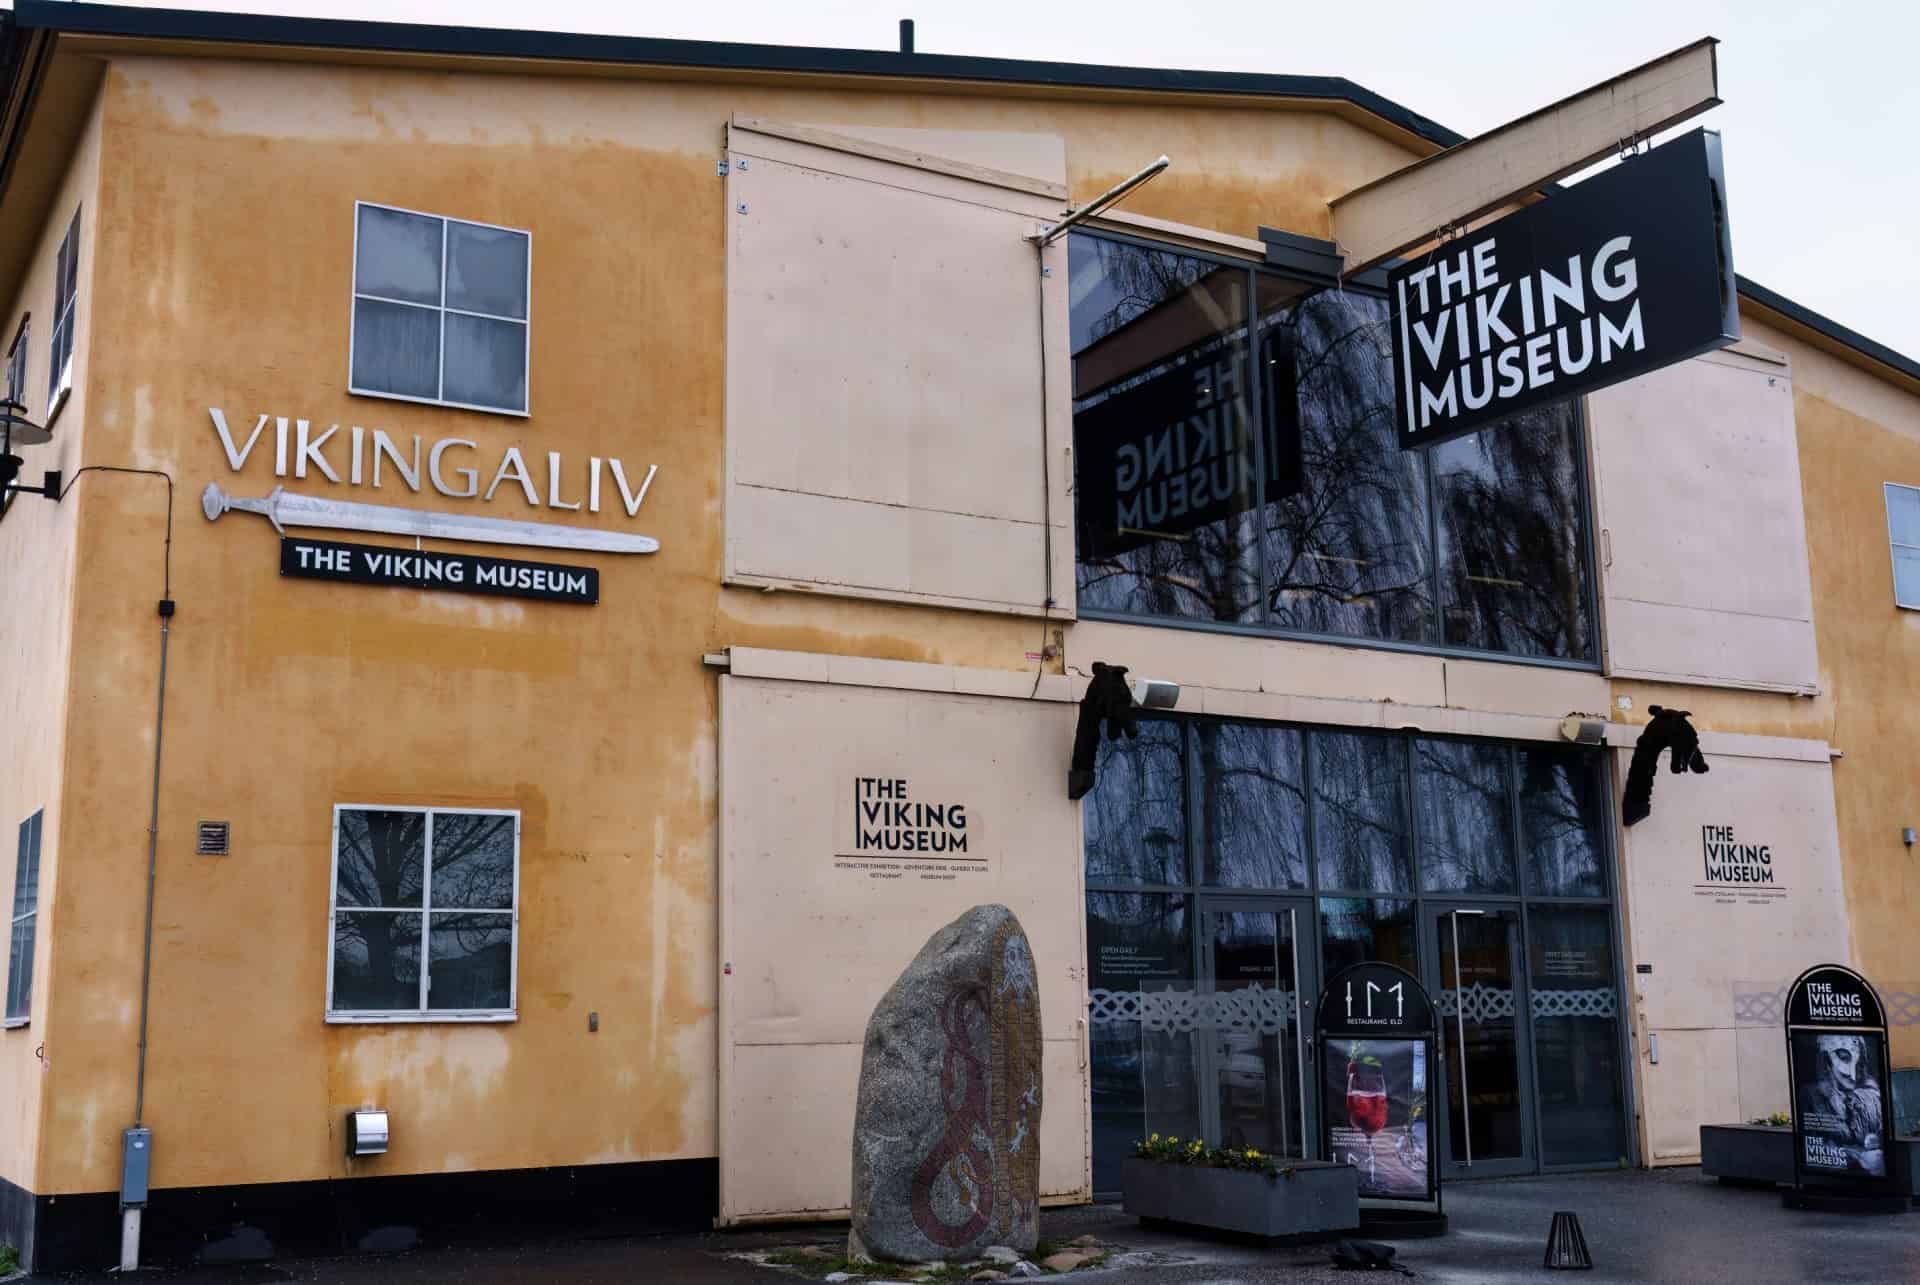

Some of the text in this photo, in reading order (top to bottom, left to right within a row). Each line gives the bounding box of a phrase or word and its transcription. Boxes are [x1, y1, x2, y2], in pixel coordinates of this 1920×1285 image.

[1410, 238, 1499, 314] THE
[1412, 235, 1638, 371] VIKING
[1420, 298, 1646, 428] MUSEUM
[208, 407, 658, 518] VIKINGALIV
[295, 545, 587, 595] THE VIKING MUSEUM
[861, 777, 907, 799] THE
[862, 801, 967, 829] VIKING
[863, 829, 968, 853] MUSEUM
[1706, 825, 1734, 842] THE
[1707, 843, 1771, 865] VIKING
[1709, 865, 1774, 883] MUSEUM
[1810, 982, 1833, 993] THE
[1811, 993, 1861, 1006] VIKING
[1813, 1006, 1863, 1017] MUSEUM
[1808, 1136, 1825, 1145] THE
[1808, 1145, 1848, 1157] VIKING
[1808, 1155, 1848, 1167] MUSEUM
